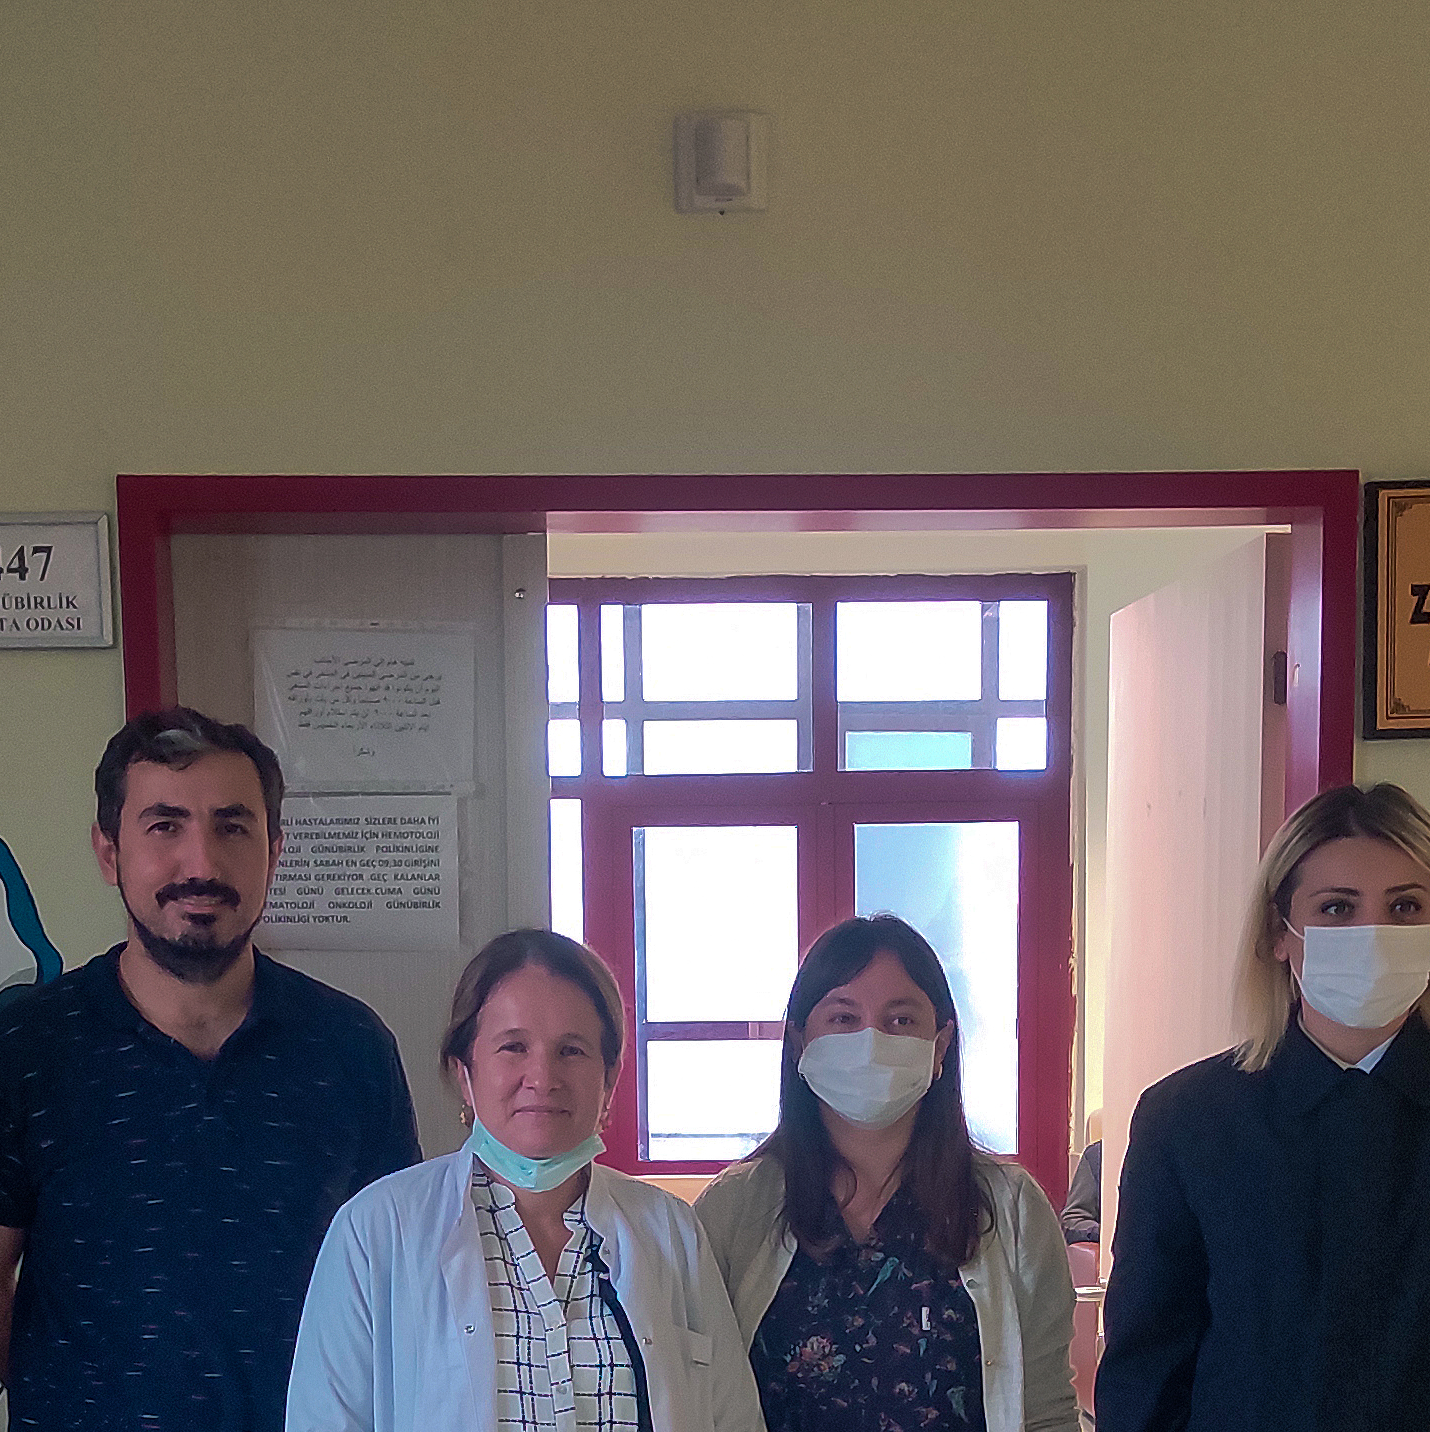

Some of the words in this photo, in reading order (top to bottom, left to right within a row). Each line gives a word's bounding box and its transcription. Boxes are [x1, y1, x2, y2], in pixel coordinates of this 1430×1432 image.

[25, 615, 83, 632] ODASI
[295, 816, 360, 826] HASTALARIMIZ
[399, 816, 426, 826] DAHA
[360, 829, 379, 841] İÇİN
[310, 843, 367, 854] GÜNÜBİRLİK
[313, 859, 344, 868] SABAH
[345, 859, 358, 868] EN
[358, 858, 376, 869] GEÇ
[393, 872, 441, 881] KALANLAR
[296, 886, 324, 896] GÜNÜ
[412, 886, 441, 896] GÜNÜ
[385, 899, 441, 910] GÜNÜBİRLİK
